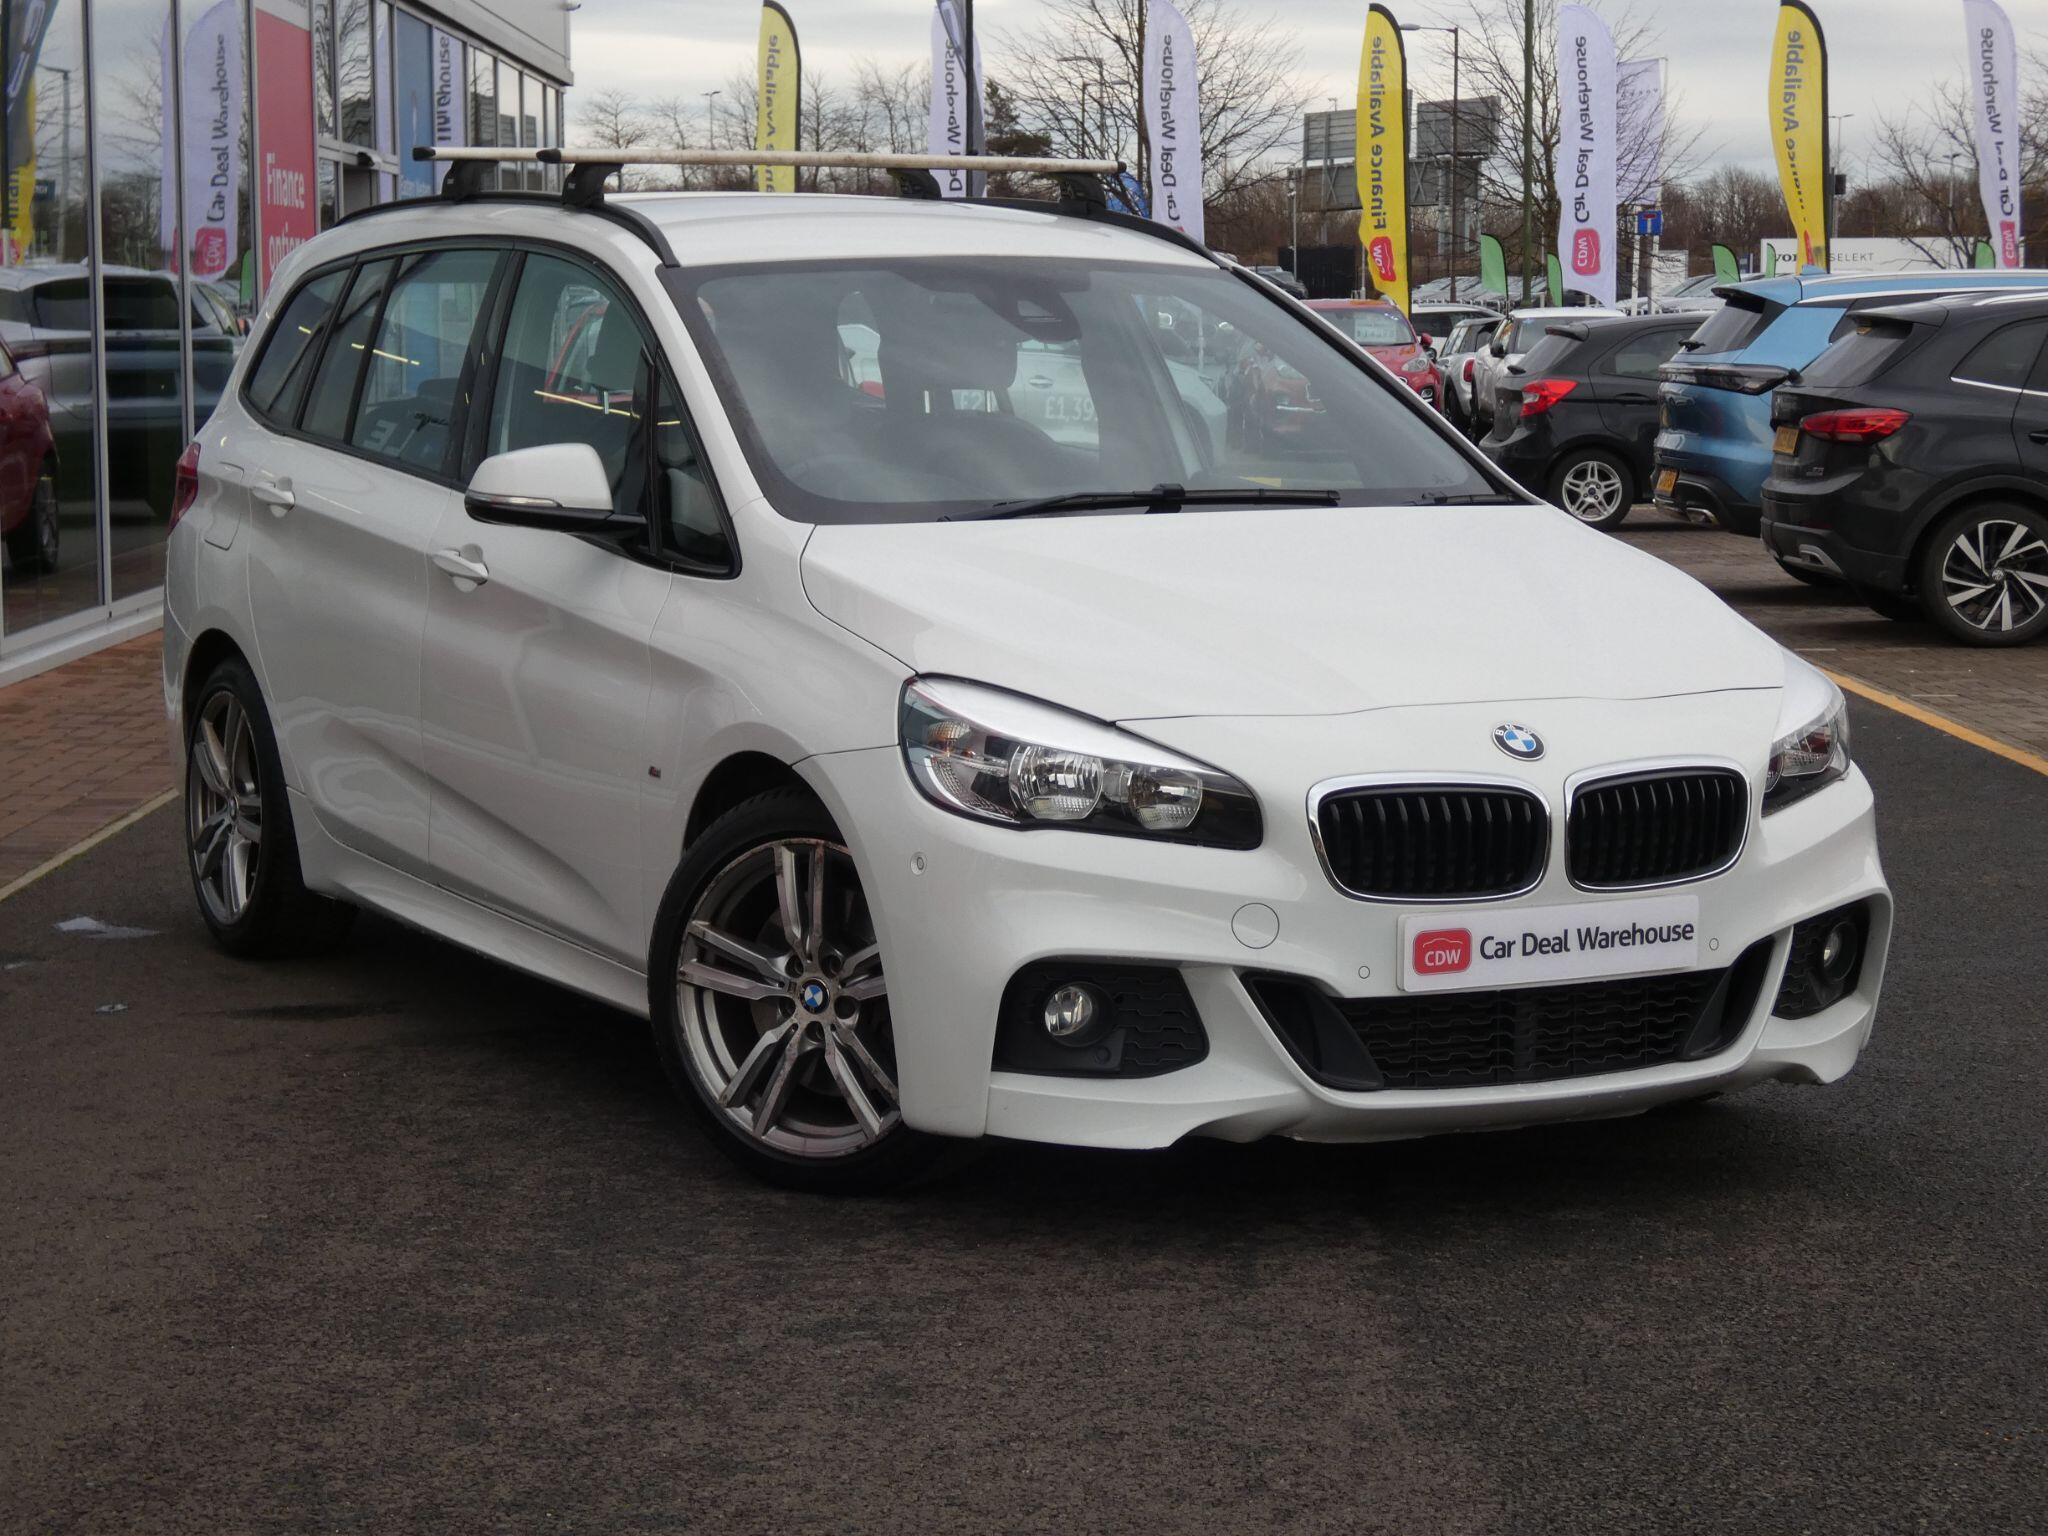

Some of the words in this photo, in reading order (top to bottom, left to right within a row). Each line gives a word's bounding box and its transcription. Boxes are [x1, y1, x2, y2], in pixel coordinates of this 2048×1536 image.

[211, 33, 229, 142] Warehouse
[210, 144, 229, 187] Deal
[265, 152, 306, 210] Finance
[207, 188, 226, 224] Car
[268, 220, 308, 273] opti
[1424, 949, 1461, 967] CDW
[1480, 936, 1516, 959] Car
[1521, 929, 1570, 957] Deal
[1577, 922, 1695, 951] Warehouse
